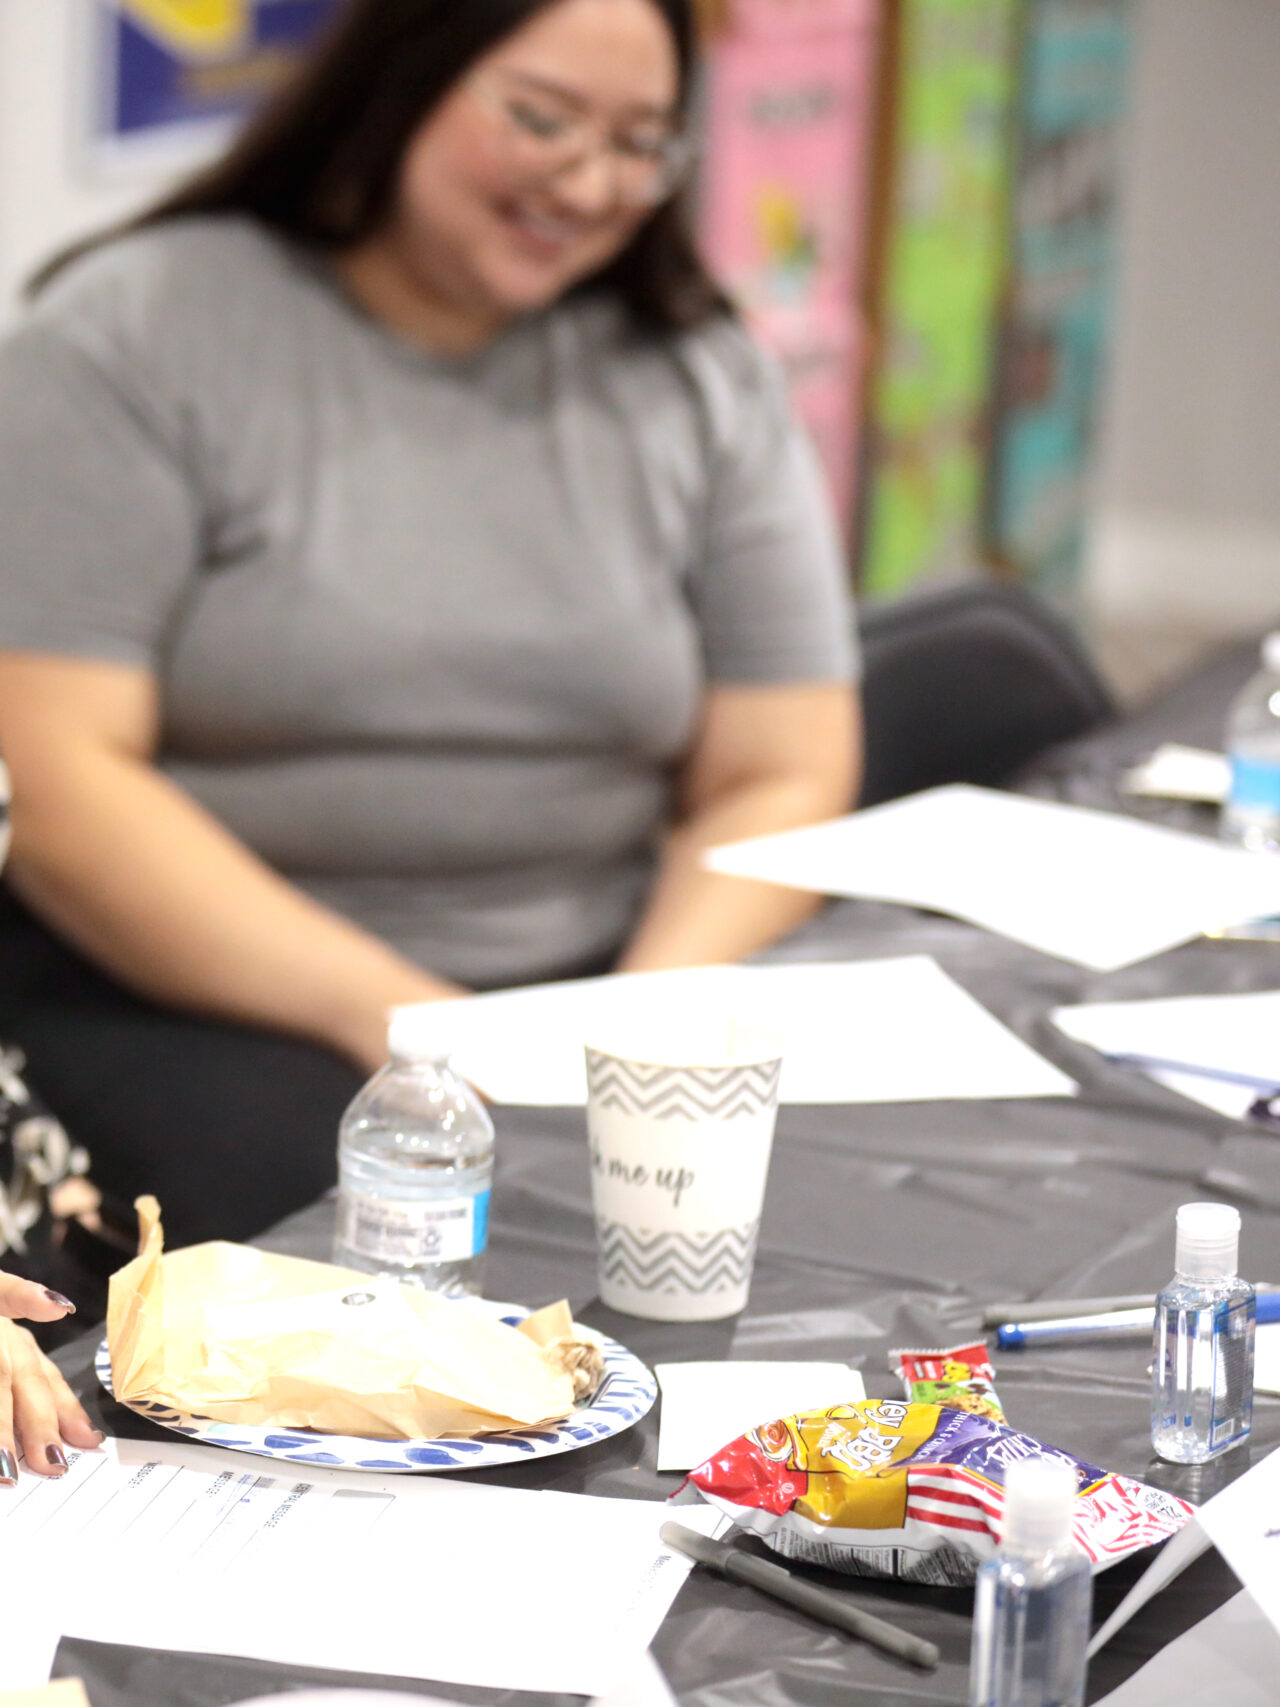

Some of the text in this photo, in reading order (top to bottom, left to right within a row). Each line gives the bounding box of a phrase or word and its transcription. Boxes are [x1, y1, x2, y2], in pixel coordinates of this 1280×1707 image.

[656, 1167, 695, 1207] up
[944, 1411, 970, 1432] THICK
[821, 1426, 904, 1471] BBQ
